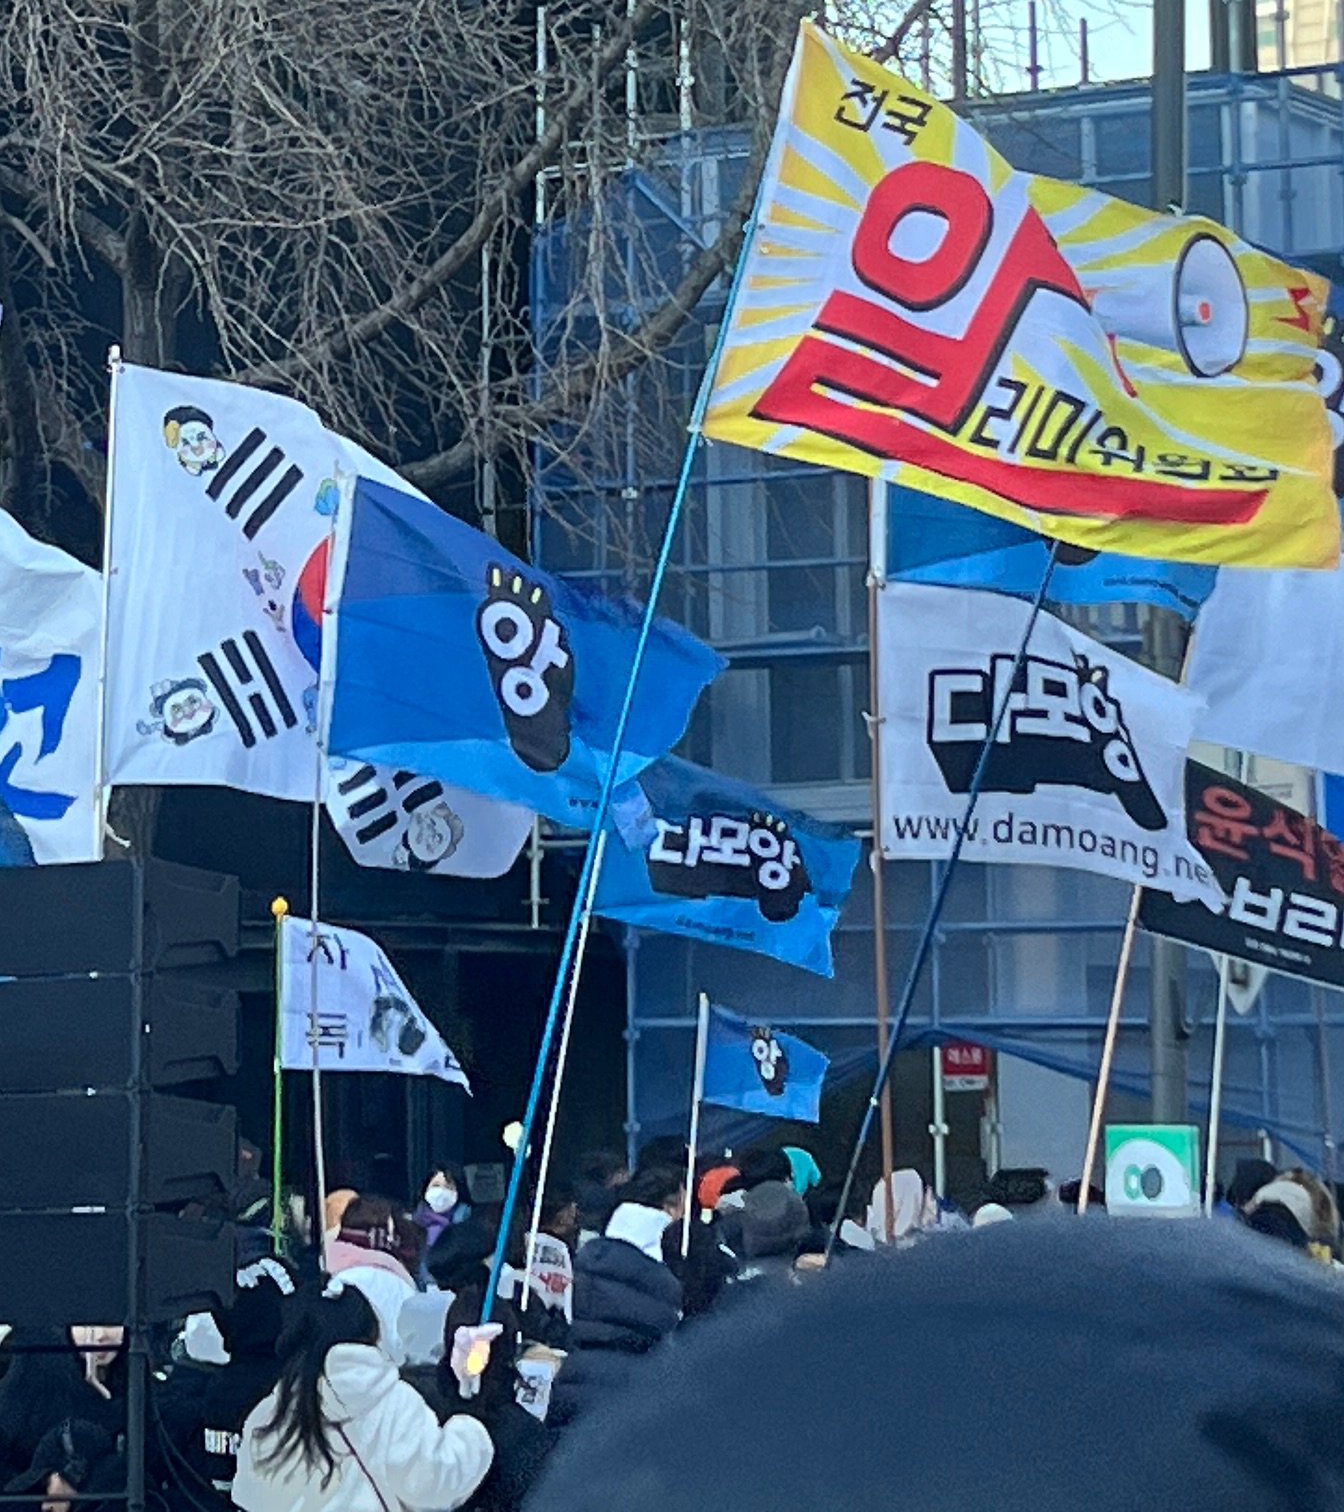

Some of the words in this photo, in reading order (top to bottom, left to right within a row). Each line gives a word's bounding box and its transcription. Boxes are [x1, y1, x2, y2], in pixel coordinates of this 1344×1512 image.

[834, 79, 933, 146] 전국
[478, 596, 570, 718] 앙
[648, 814, 802, 889] 다모앙
[893, 812, 1214, 887] www.damoang.ne
